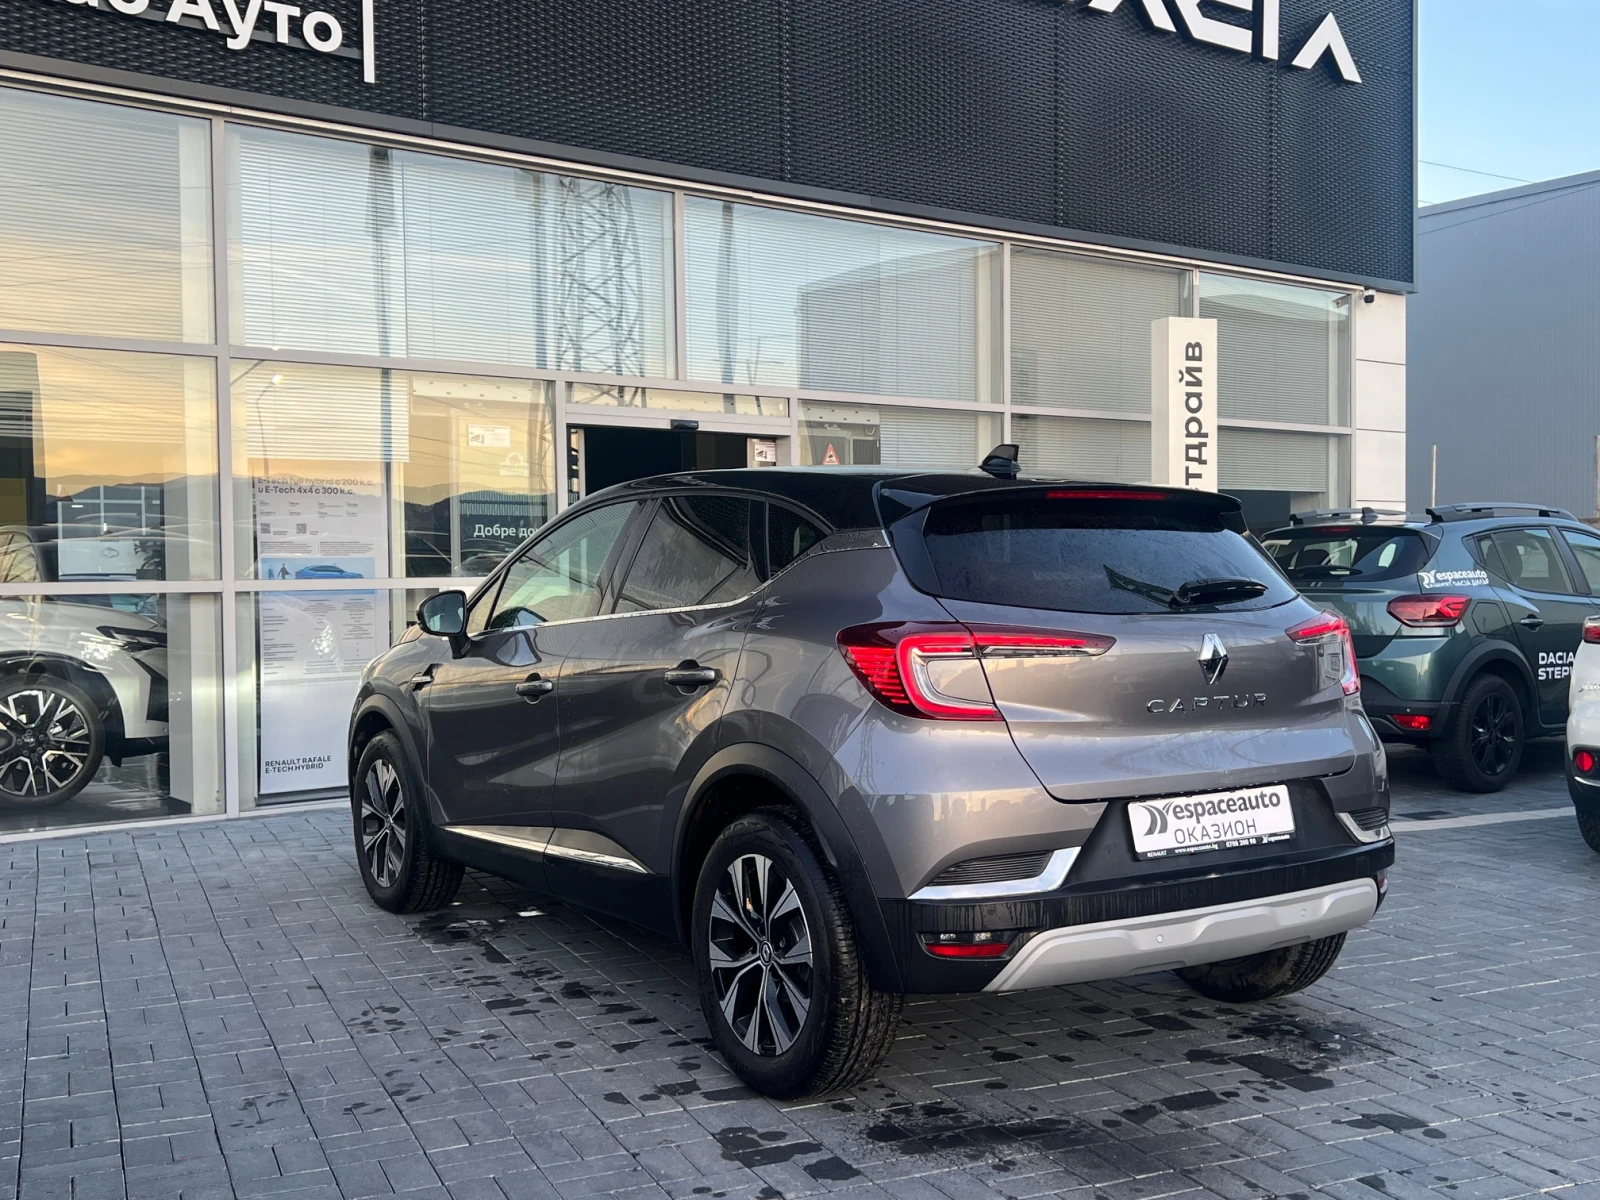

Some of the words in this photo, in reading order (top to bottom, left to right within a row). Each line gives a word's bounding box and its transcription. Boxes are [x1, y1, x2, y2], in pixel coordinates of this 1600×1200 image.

[1179, 341, 1209, 490] тдрайв
[290, 477, 305, 485] full
[305, 477, 334, 487] hybrid
[342, 478, 358, 486] 200
[265, 486, 295, 494] E-Tech
[296, 486, 314, 494] 4x4
[322, 487, 339, 495] 300
[473, 524, 516, 539] Добре
[518, 527, 540, 538] до
[1435, 569, 1488, 581] espaceauto
[1538, 651, 1575, 665] DACIA
[1538, 666, 1573, 680] STEP
[1146, 692, 1267, 714] CAPTUR
[265, 758, 301, 768] RENAULT
[302, 755, 332, 764] RAFALE
[265, 766, 294, 774] E-TECH
[294, 763, 324, 771] HYBRID
[1172, 790, 1281, 824] espaceauto
[1174, 818, 1257, 844] ОКАЗИОН
[1146, 850, 1167, 858] RENAULT
[1225, 839, 1239, 848] 0700
